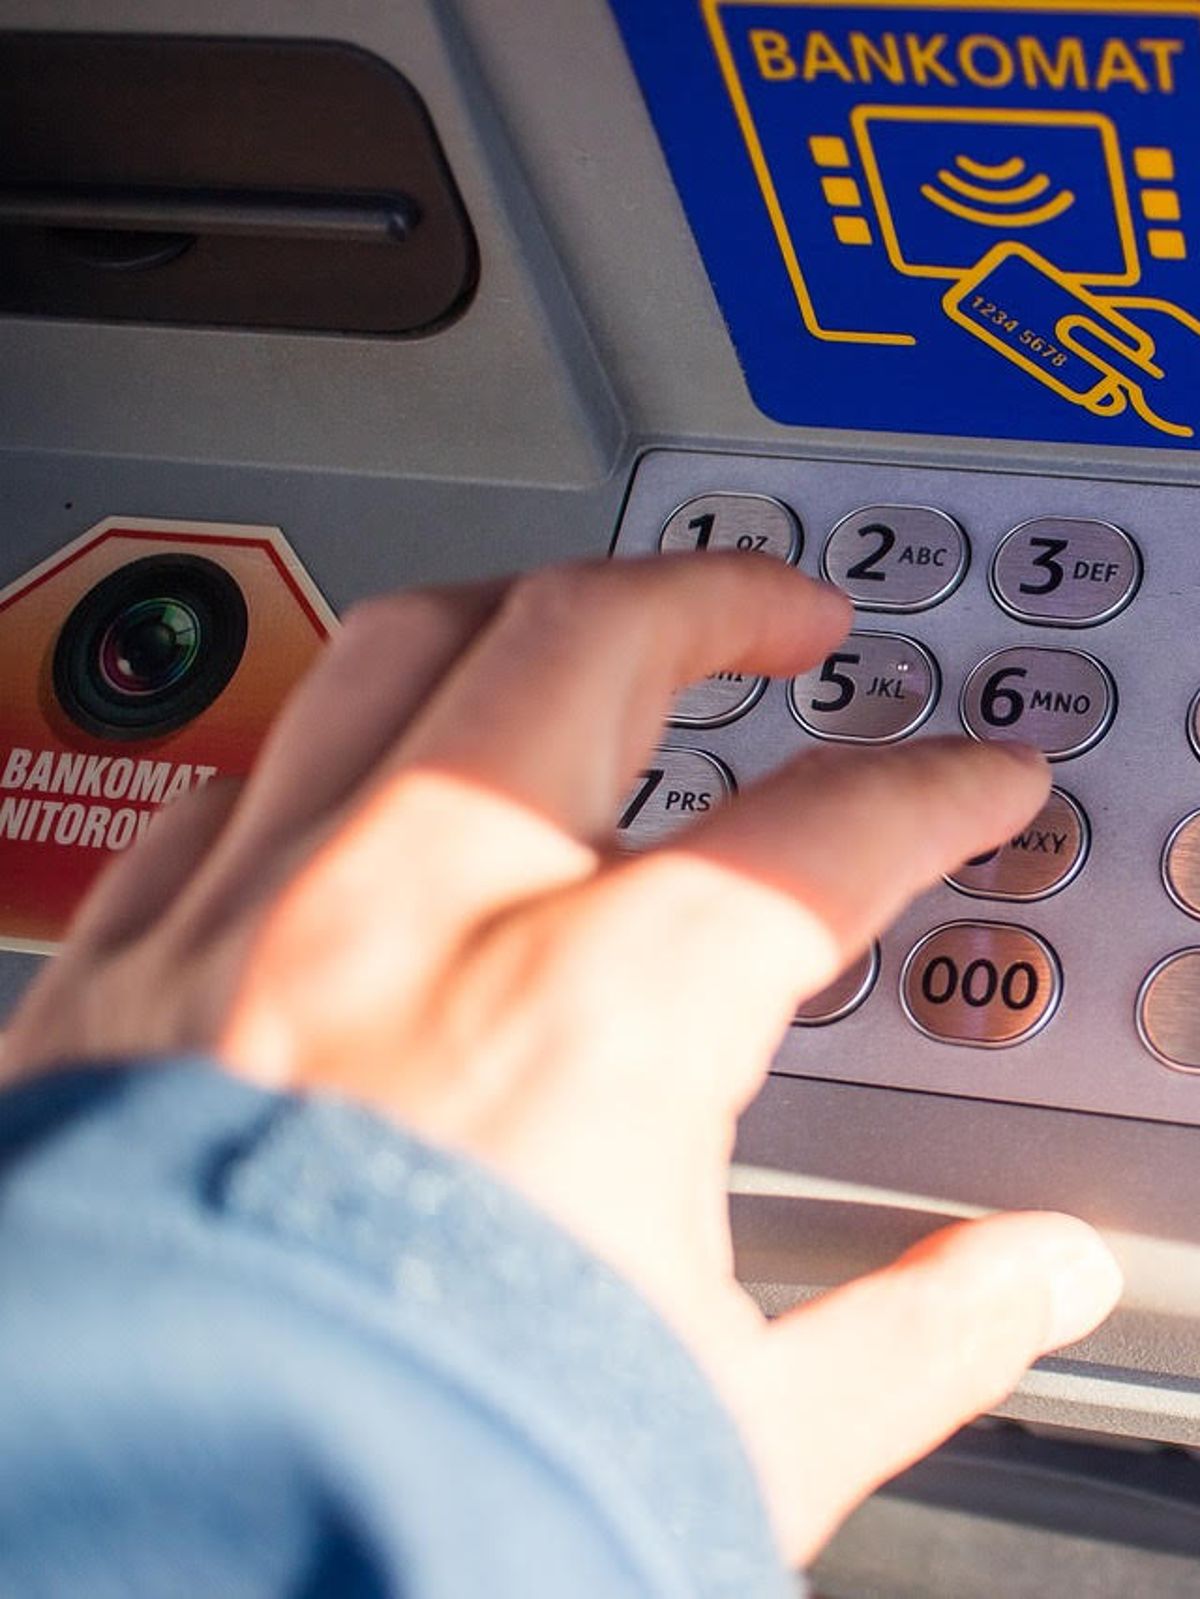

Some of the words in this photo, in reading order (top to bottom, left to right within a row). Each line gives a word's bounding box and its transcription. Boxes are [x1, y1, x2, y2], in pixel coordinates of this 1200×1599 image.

[748, 29, 1183, 94] BANKOMAT
[971, 296, 1019, 333] 1234
[1019, 329, 1067, 367] 5678
[687, 513, 716, 553] 1
[846, 523, 897, 582] 2
[899, 547, 948, 569] ABC
[1018, 536, 1069, 596] 3
[1073, 561, 1121, 584] DEF
[811, 652, 861, 713] 5
[866, 676, 906, 700] JKL
[979, 666, 1029, 728] 6
[1029, 690, 1091, 716] MNO
[0, 747, 218, 804] BANKOMAT
[616, 768, 665, 829] 7
[665, 790, 712, 812] PRS
